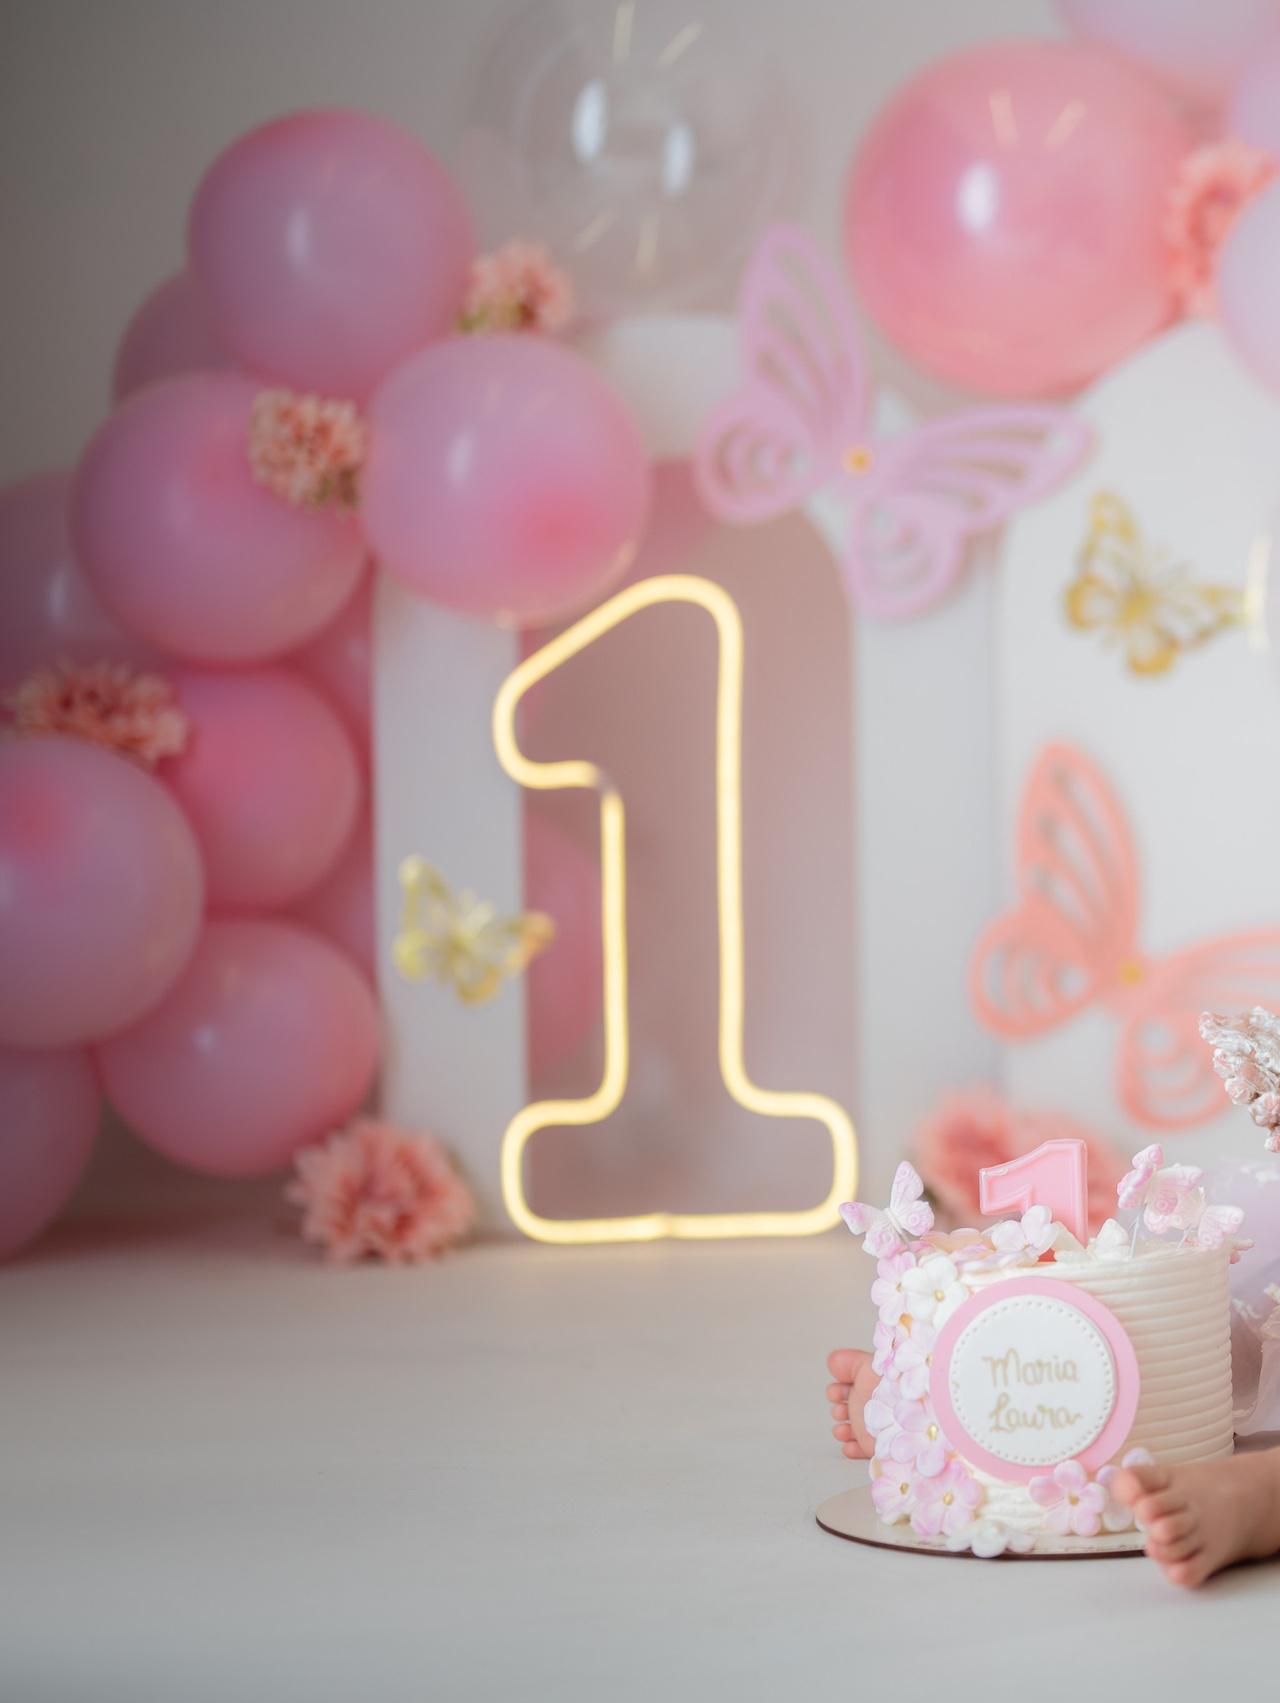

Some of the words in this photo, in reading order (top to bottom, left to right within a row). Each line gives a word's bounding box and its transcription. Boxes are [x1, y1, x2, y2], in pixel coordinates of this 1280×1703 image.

[492, 574, 859, 1243] 1
[979, 1139, 1089, 1260] 1
[981, 1347, 1080, 1388] Maria
[988, 1392, 1084, 1434] Laura
